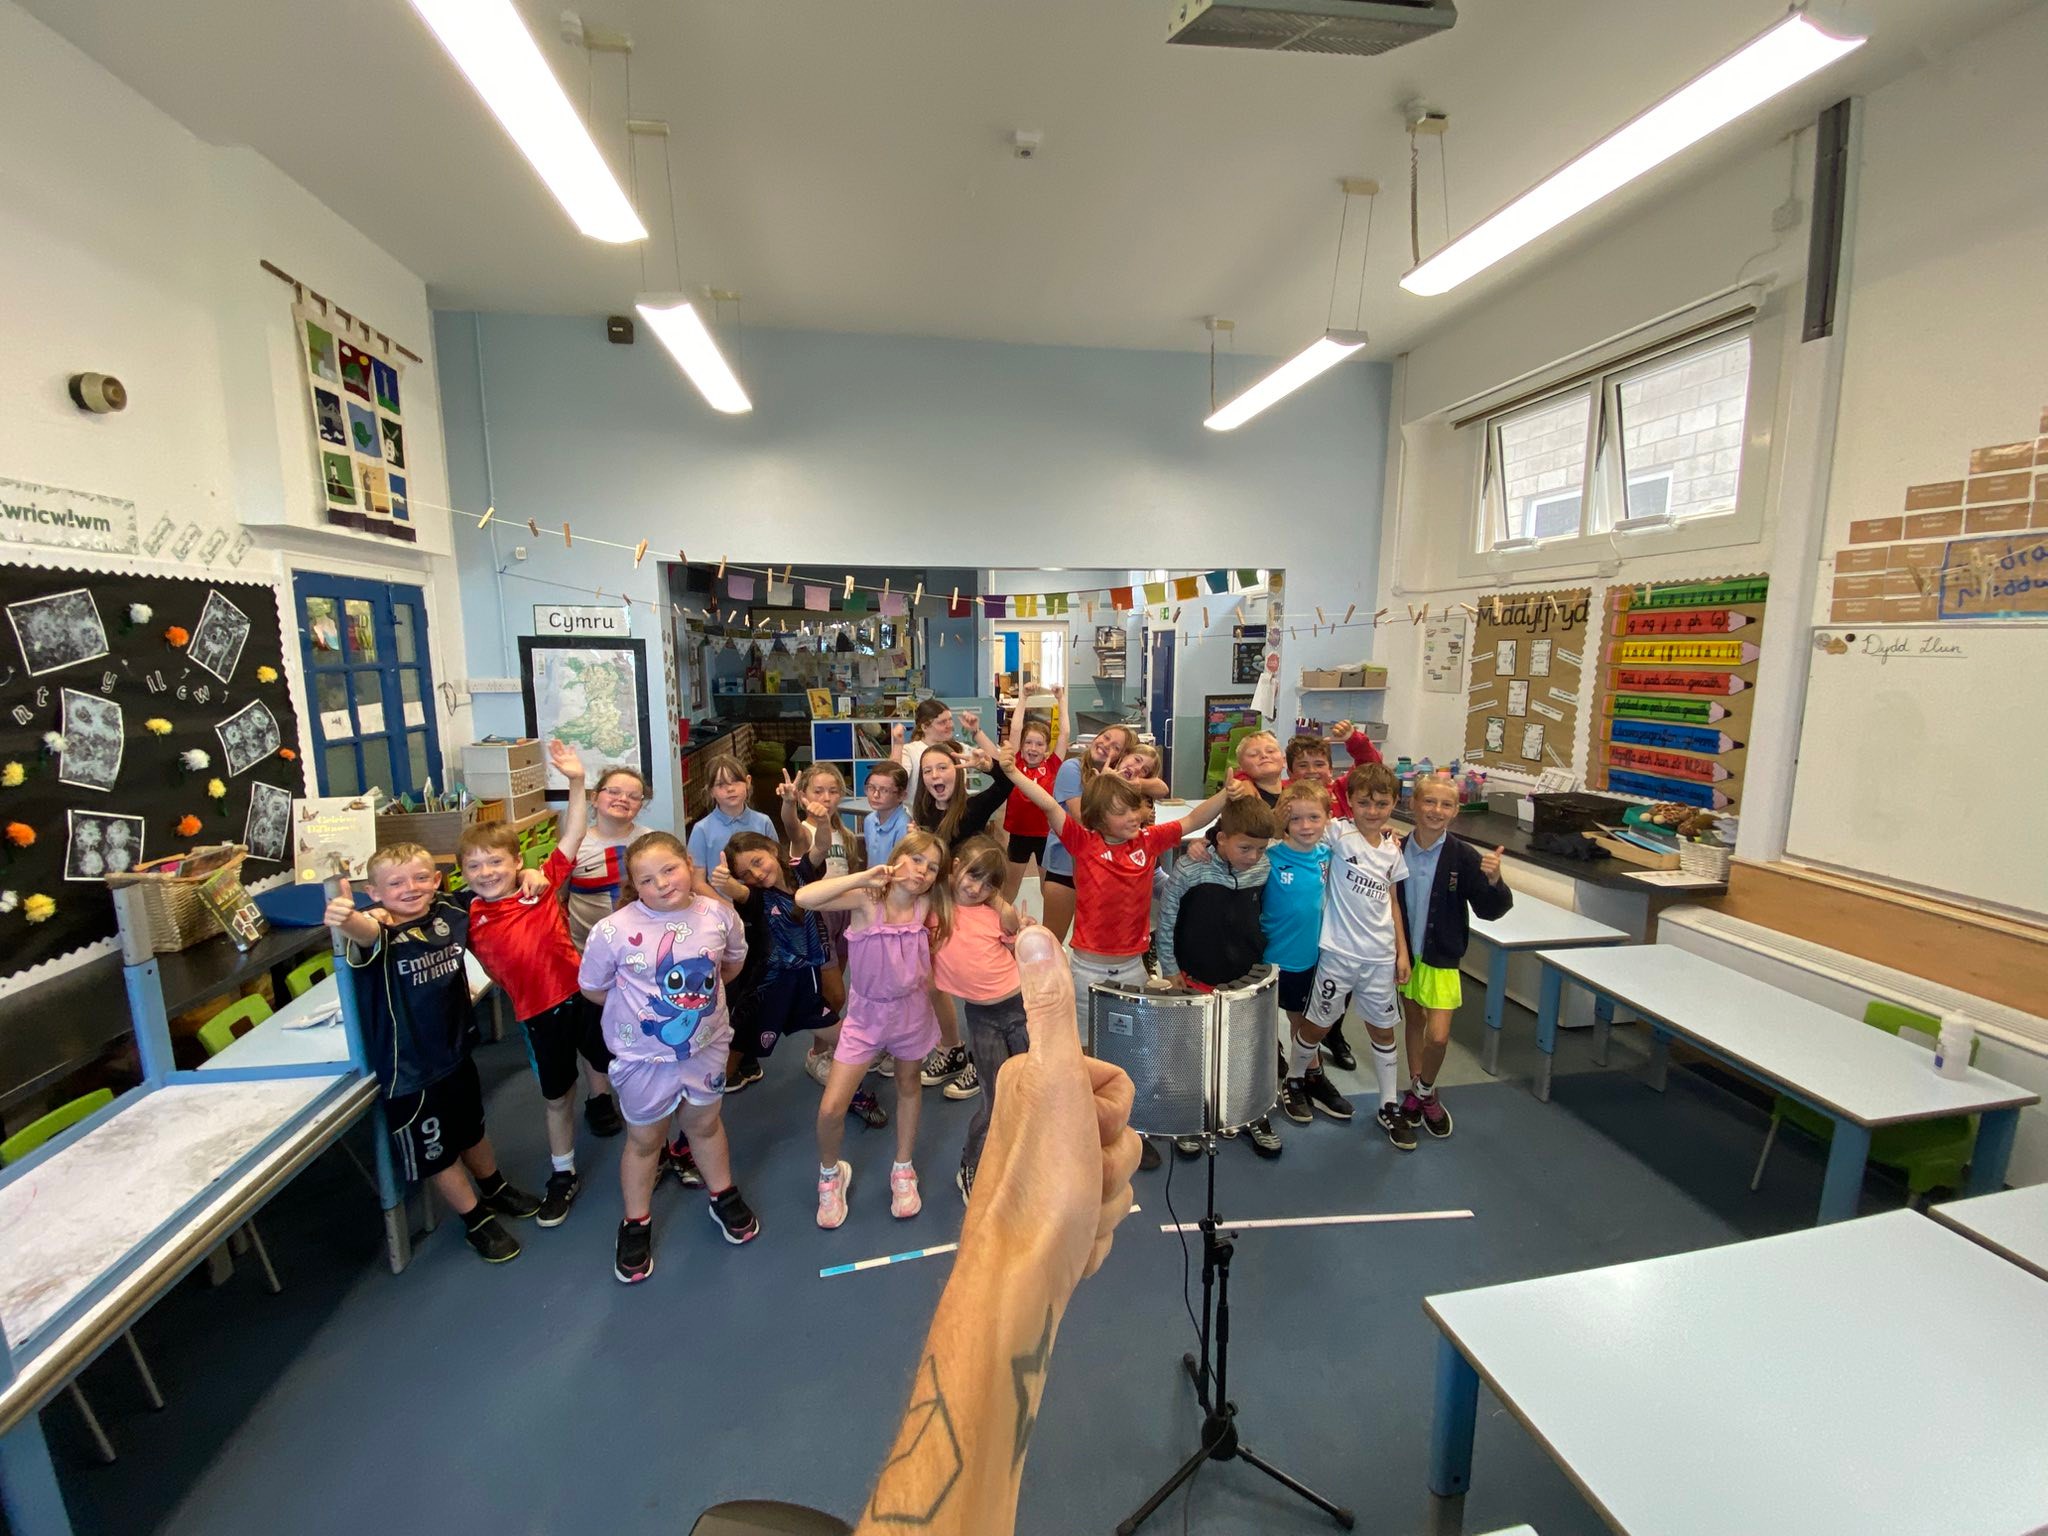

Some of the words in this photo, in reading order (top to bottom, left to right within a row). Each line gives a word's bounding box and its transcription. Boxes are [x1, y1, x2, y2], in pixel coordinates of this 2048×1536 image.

[549, 612, 615, 633] Cymru
[1862, 633, 1909, 665] Dydd
[1280, 871, 1294, 884] SF
[397, 942, 463, 976] Emirates
[412, 972, 428, 986] FLY
[431, 958, 460, 980] BETTER
[1321, 979, 1337, 1000] 9
[421, 1116, 441, 1144] 9
